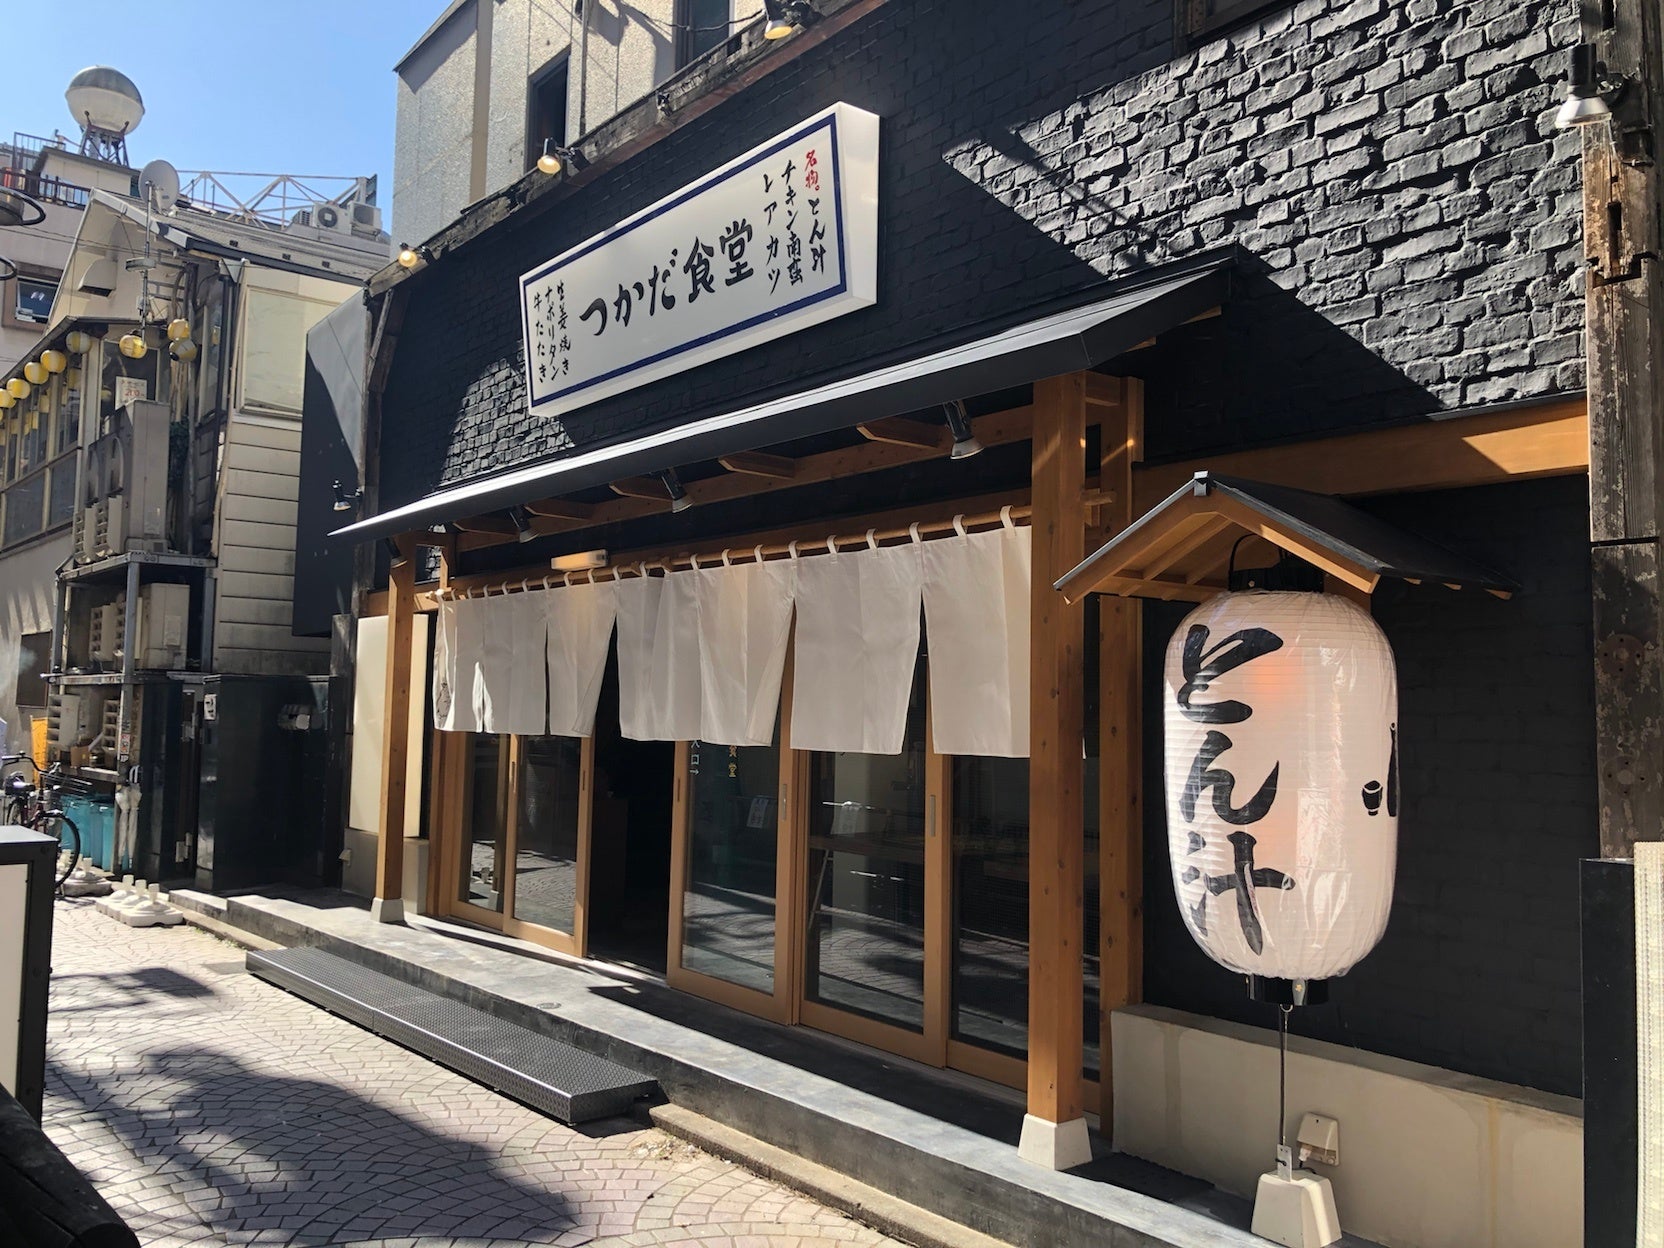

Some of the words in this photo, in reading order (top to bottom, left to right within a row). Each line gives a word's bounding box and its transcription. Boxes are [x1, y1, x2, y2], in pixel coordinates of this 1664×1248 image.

[579, 217, 754, 336] つかだ食堂
[763, 173, 781, 296] レアカツ
[534, 292, 547, 383] 牛たたき
[545, 286, 560, 380] ナポリタン
[556, 280, 571, 375] 生姜焼き
[1177, 624, 1296, 955] とん汁
